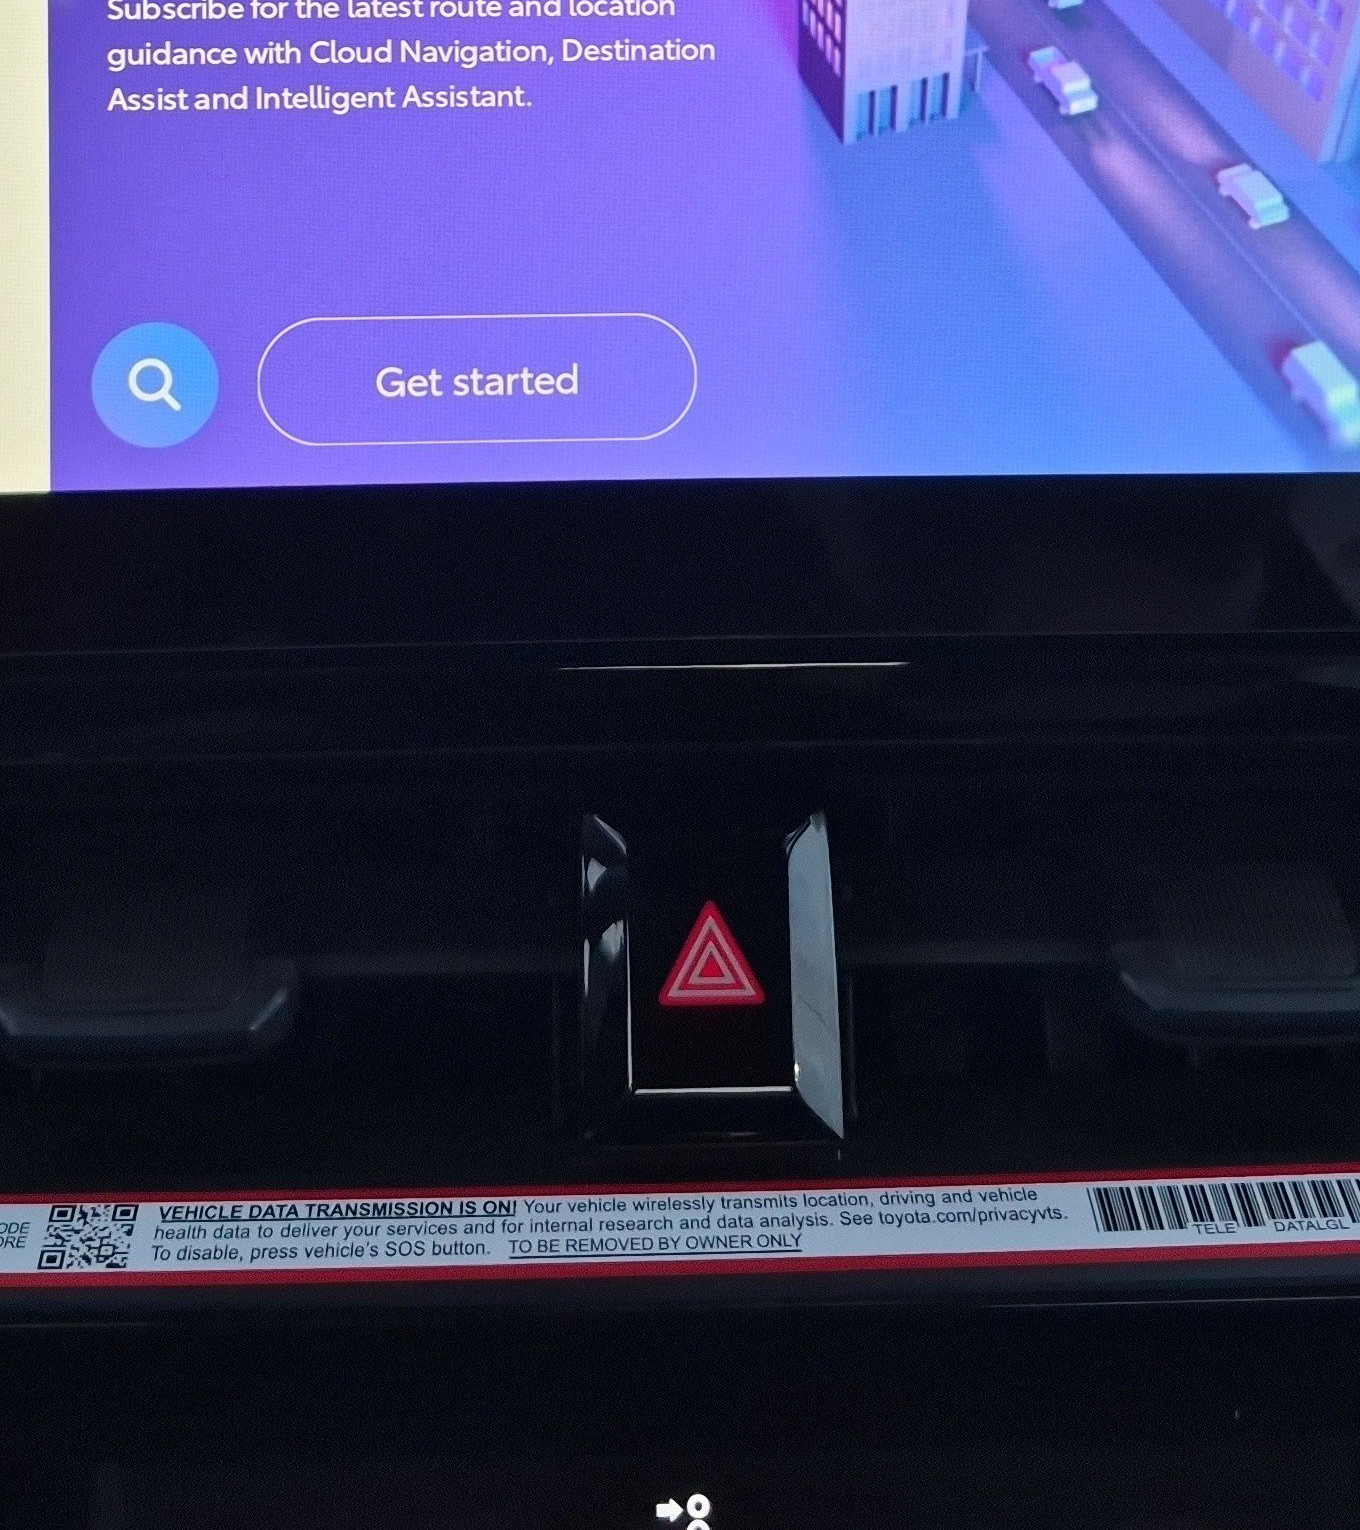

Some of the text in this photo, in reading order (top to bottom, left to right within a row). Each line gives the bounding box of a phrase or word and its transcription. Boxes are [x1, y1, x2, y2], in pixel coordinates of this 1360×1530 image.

[107, 37, 716, 73] guidance with Cloud Navigation, Destination
[107, 84, 533, 116] Assist and Intelligent Assistant.
[375, 362, 580, 399] Get started
[158, 1187, 1039, 1221] VEHICLE DATA TRANSMISSION IS ON! Your vehicle wirelessly transmits location, driving and vehicle
[153, 1224, 208, 1241] health
[212, 1223, 251, 1240] data
[257, 1224, 274, 1239] to
[279, 1222, 339, 1239] deliver
[343, 1223, 382, 1241] your
[386, 1220, 458, 1237] services
[463, 1219, 496, 1235] and
[500, 1218, 525, 1235] for
[529, 1217, 594, 1234] internal
[598, 1215, 674, 1232] research
[679, 1214, 712, 1230] and
[716, 1213, 755, 1230] data
[764, 1211, 835, 1231] analysis.
[839, 1210, 874, 1227] See
[1192, 1221, 1239, 1235] TELE
[151, 1232, 803, 1264] To disable, press vehicle's SOS button. TO BE REMOVED BY OWNER ONLY
